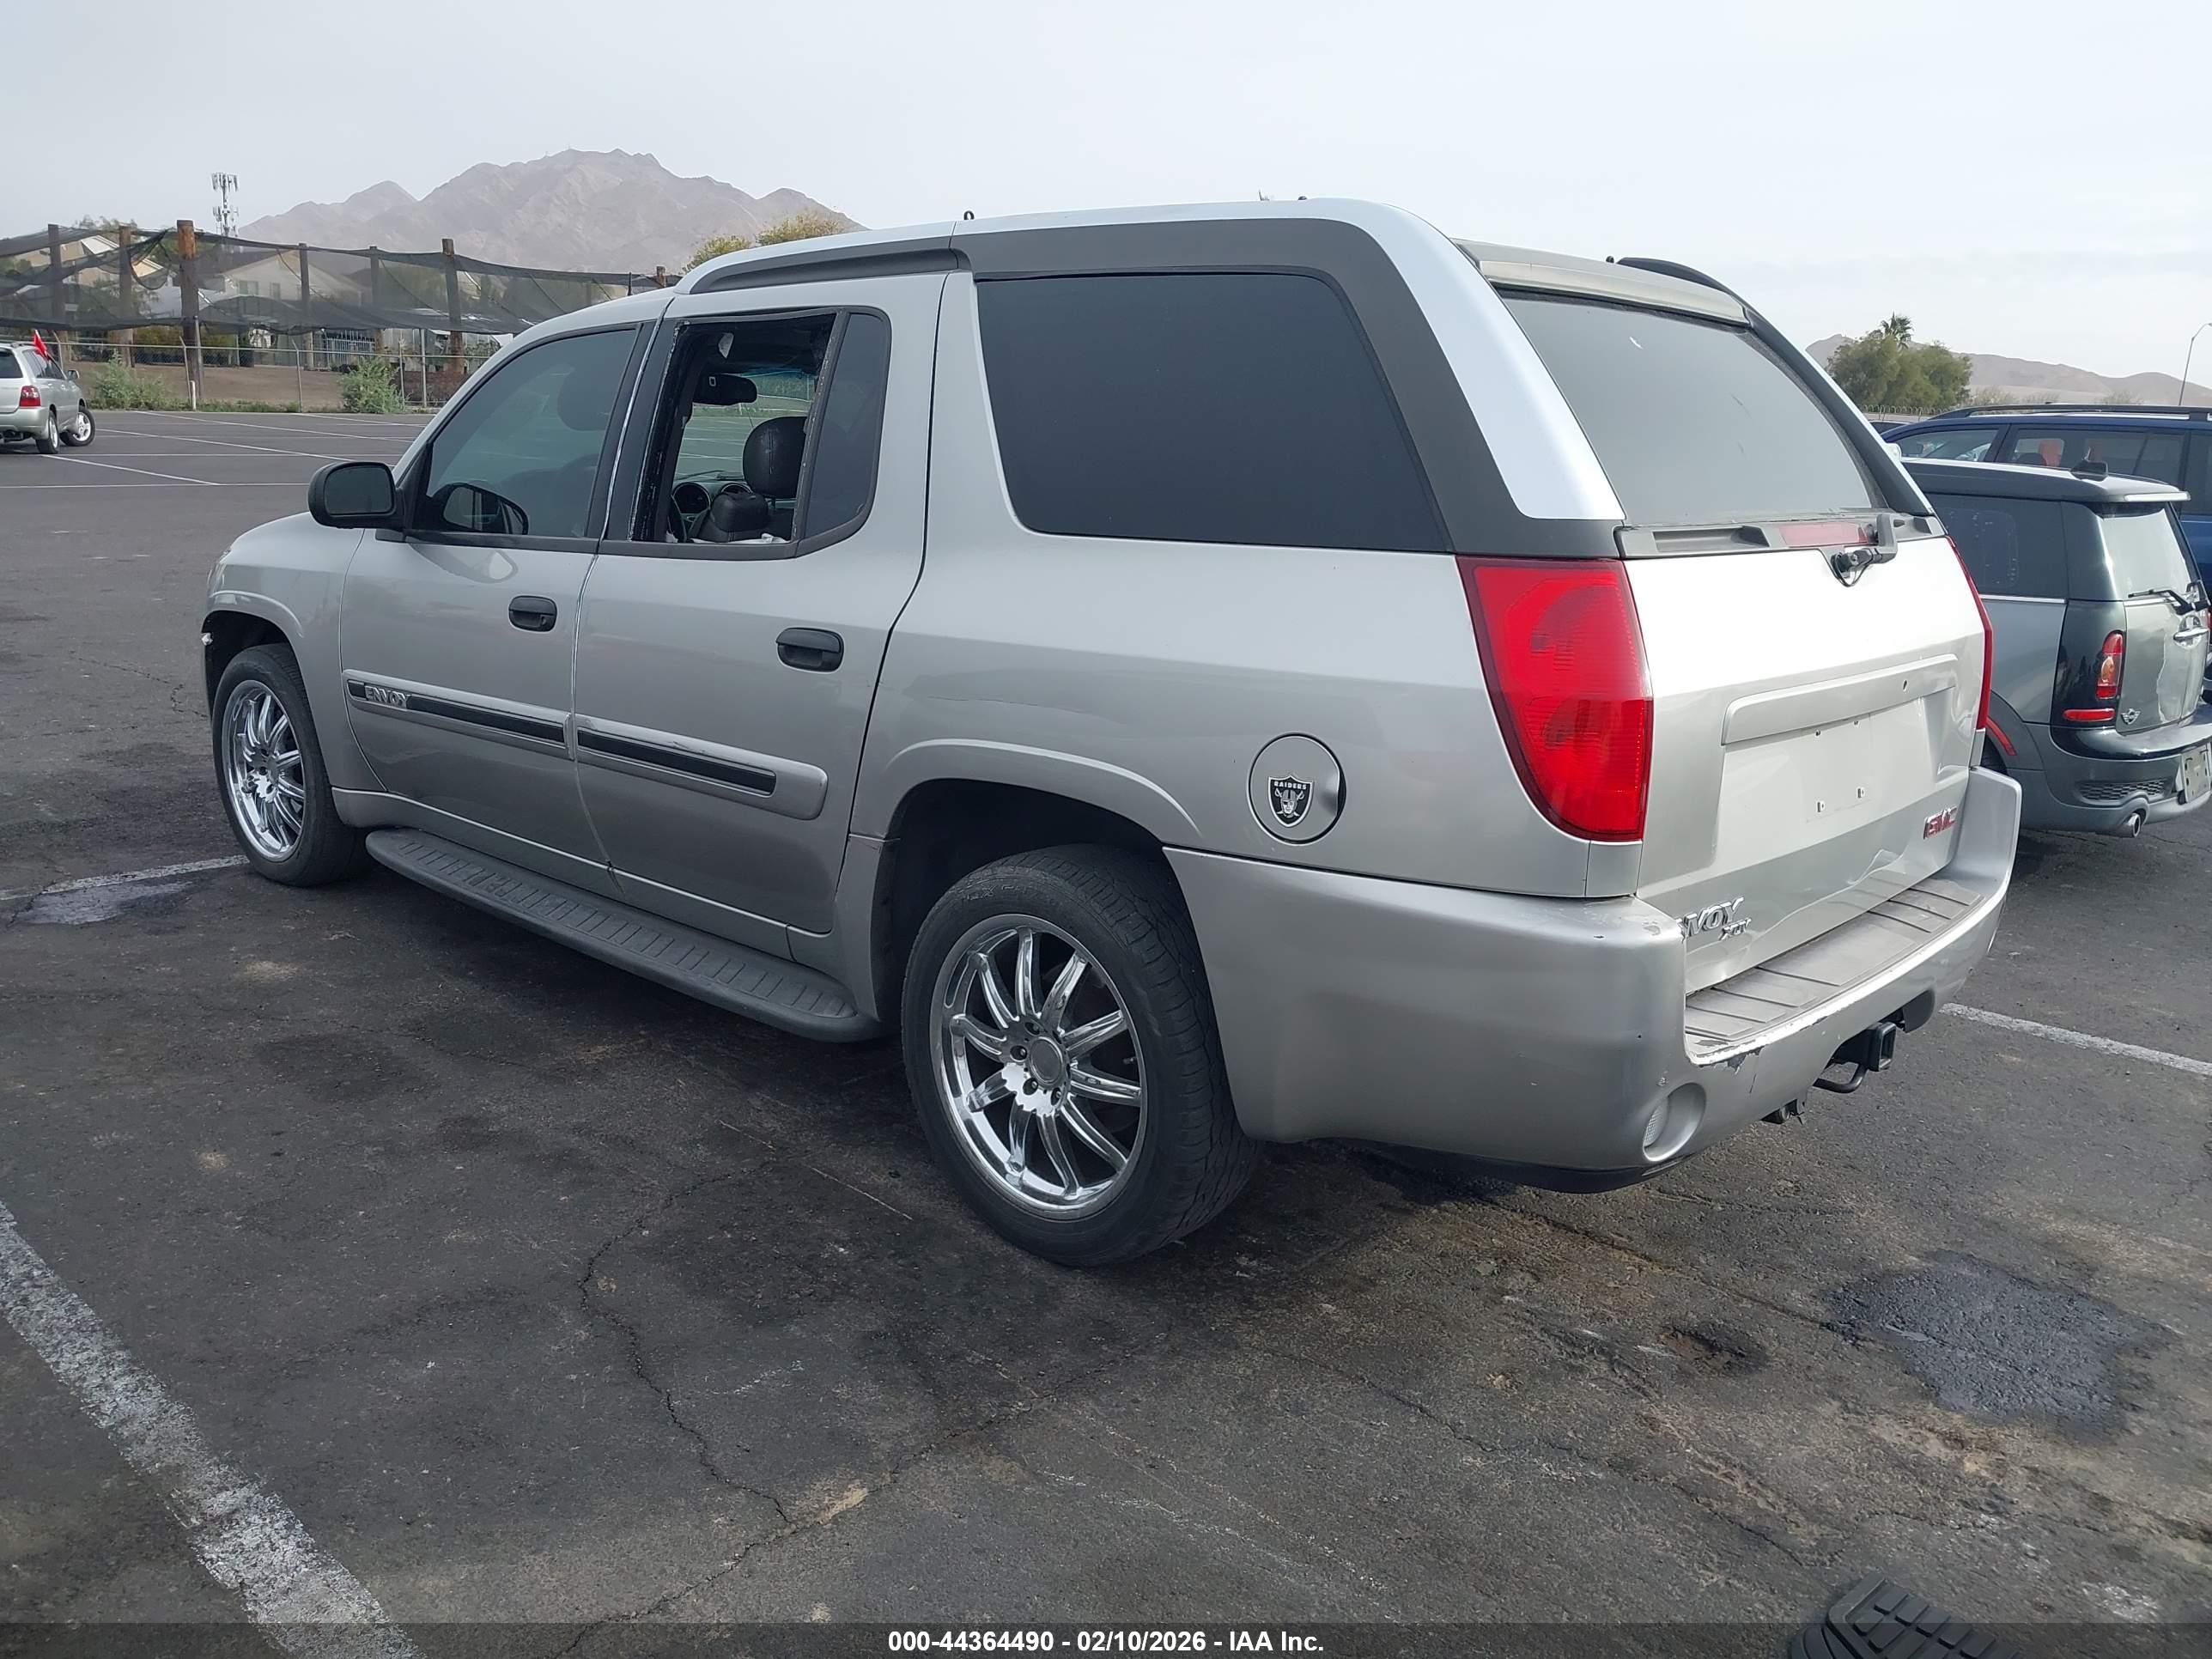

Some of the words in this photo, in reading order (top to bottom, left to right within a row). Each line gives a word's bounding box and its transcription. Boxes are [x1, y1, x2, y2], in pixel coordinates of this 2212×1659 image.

[365, 685, 411, 710] ENVOY
[1273, 781, 1307, 790] RAIDERS
[1923, 805, 1957, 839] GMC
